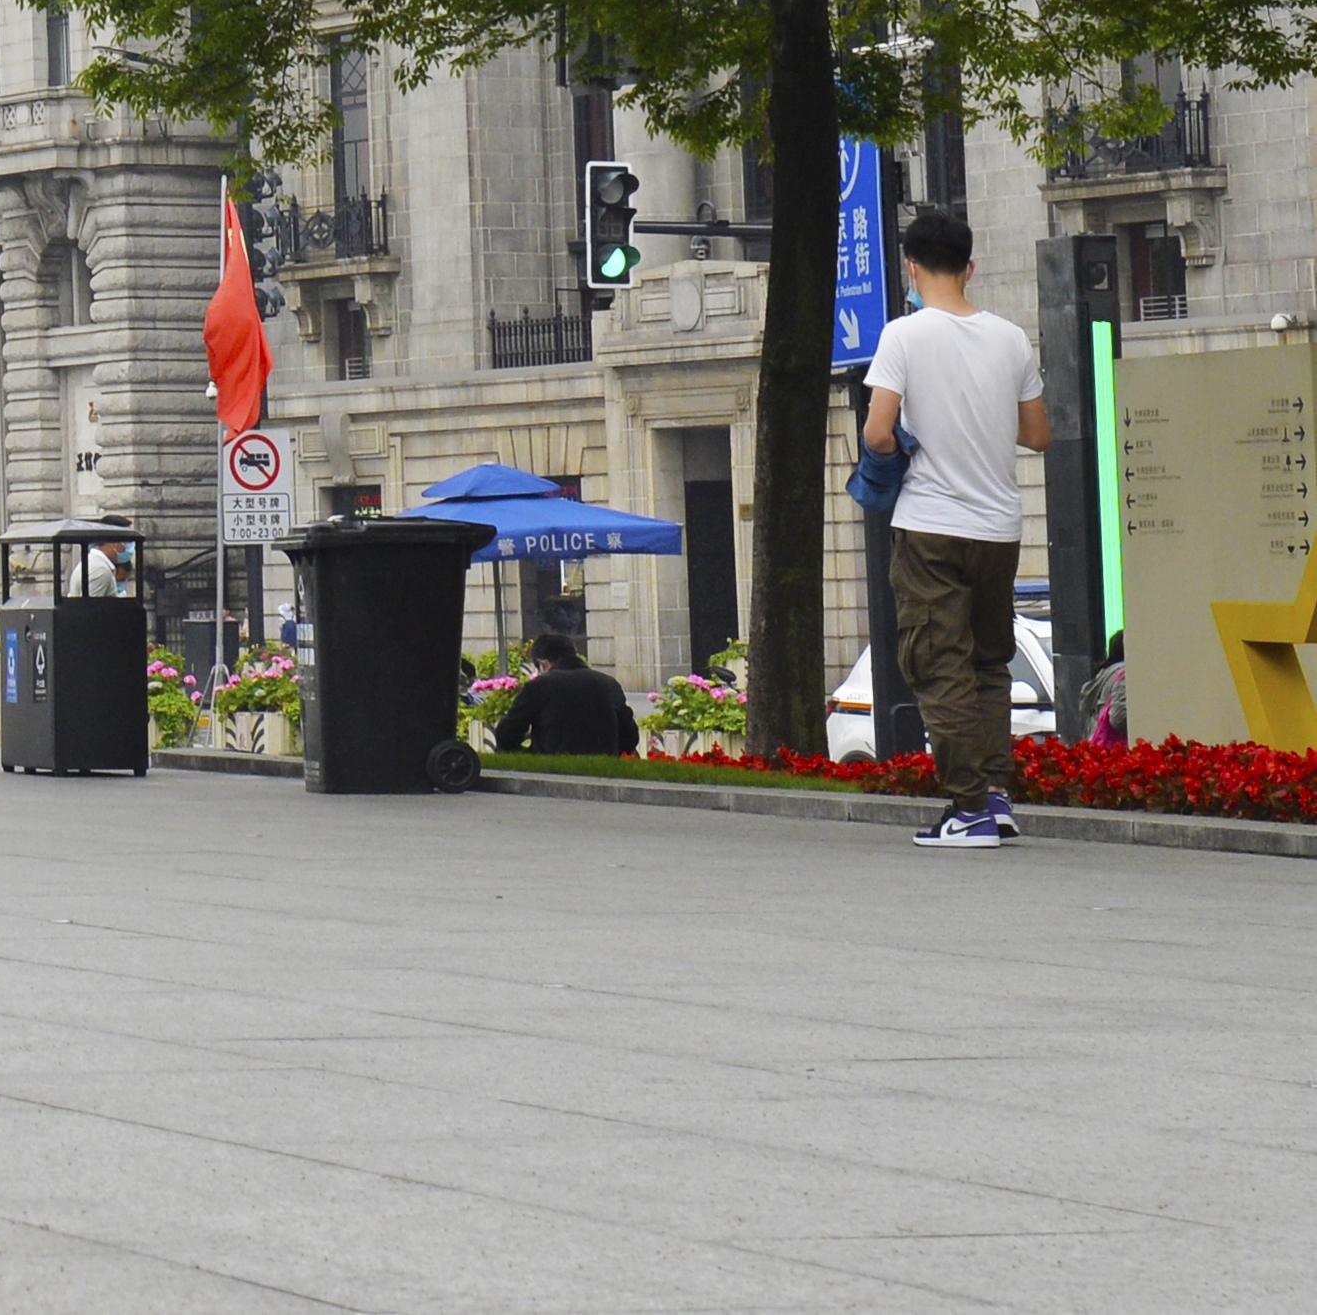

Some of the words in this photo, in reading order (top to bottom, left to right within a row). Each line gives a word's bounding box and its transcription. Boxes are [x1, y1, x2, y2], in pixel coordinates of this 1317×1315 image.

[232, 497, 280, 509] 大型号牌
[233, 514, 281, 526] 小型号牌
[525, 533, 596, 554] POLICE
